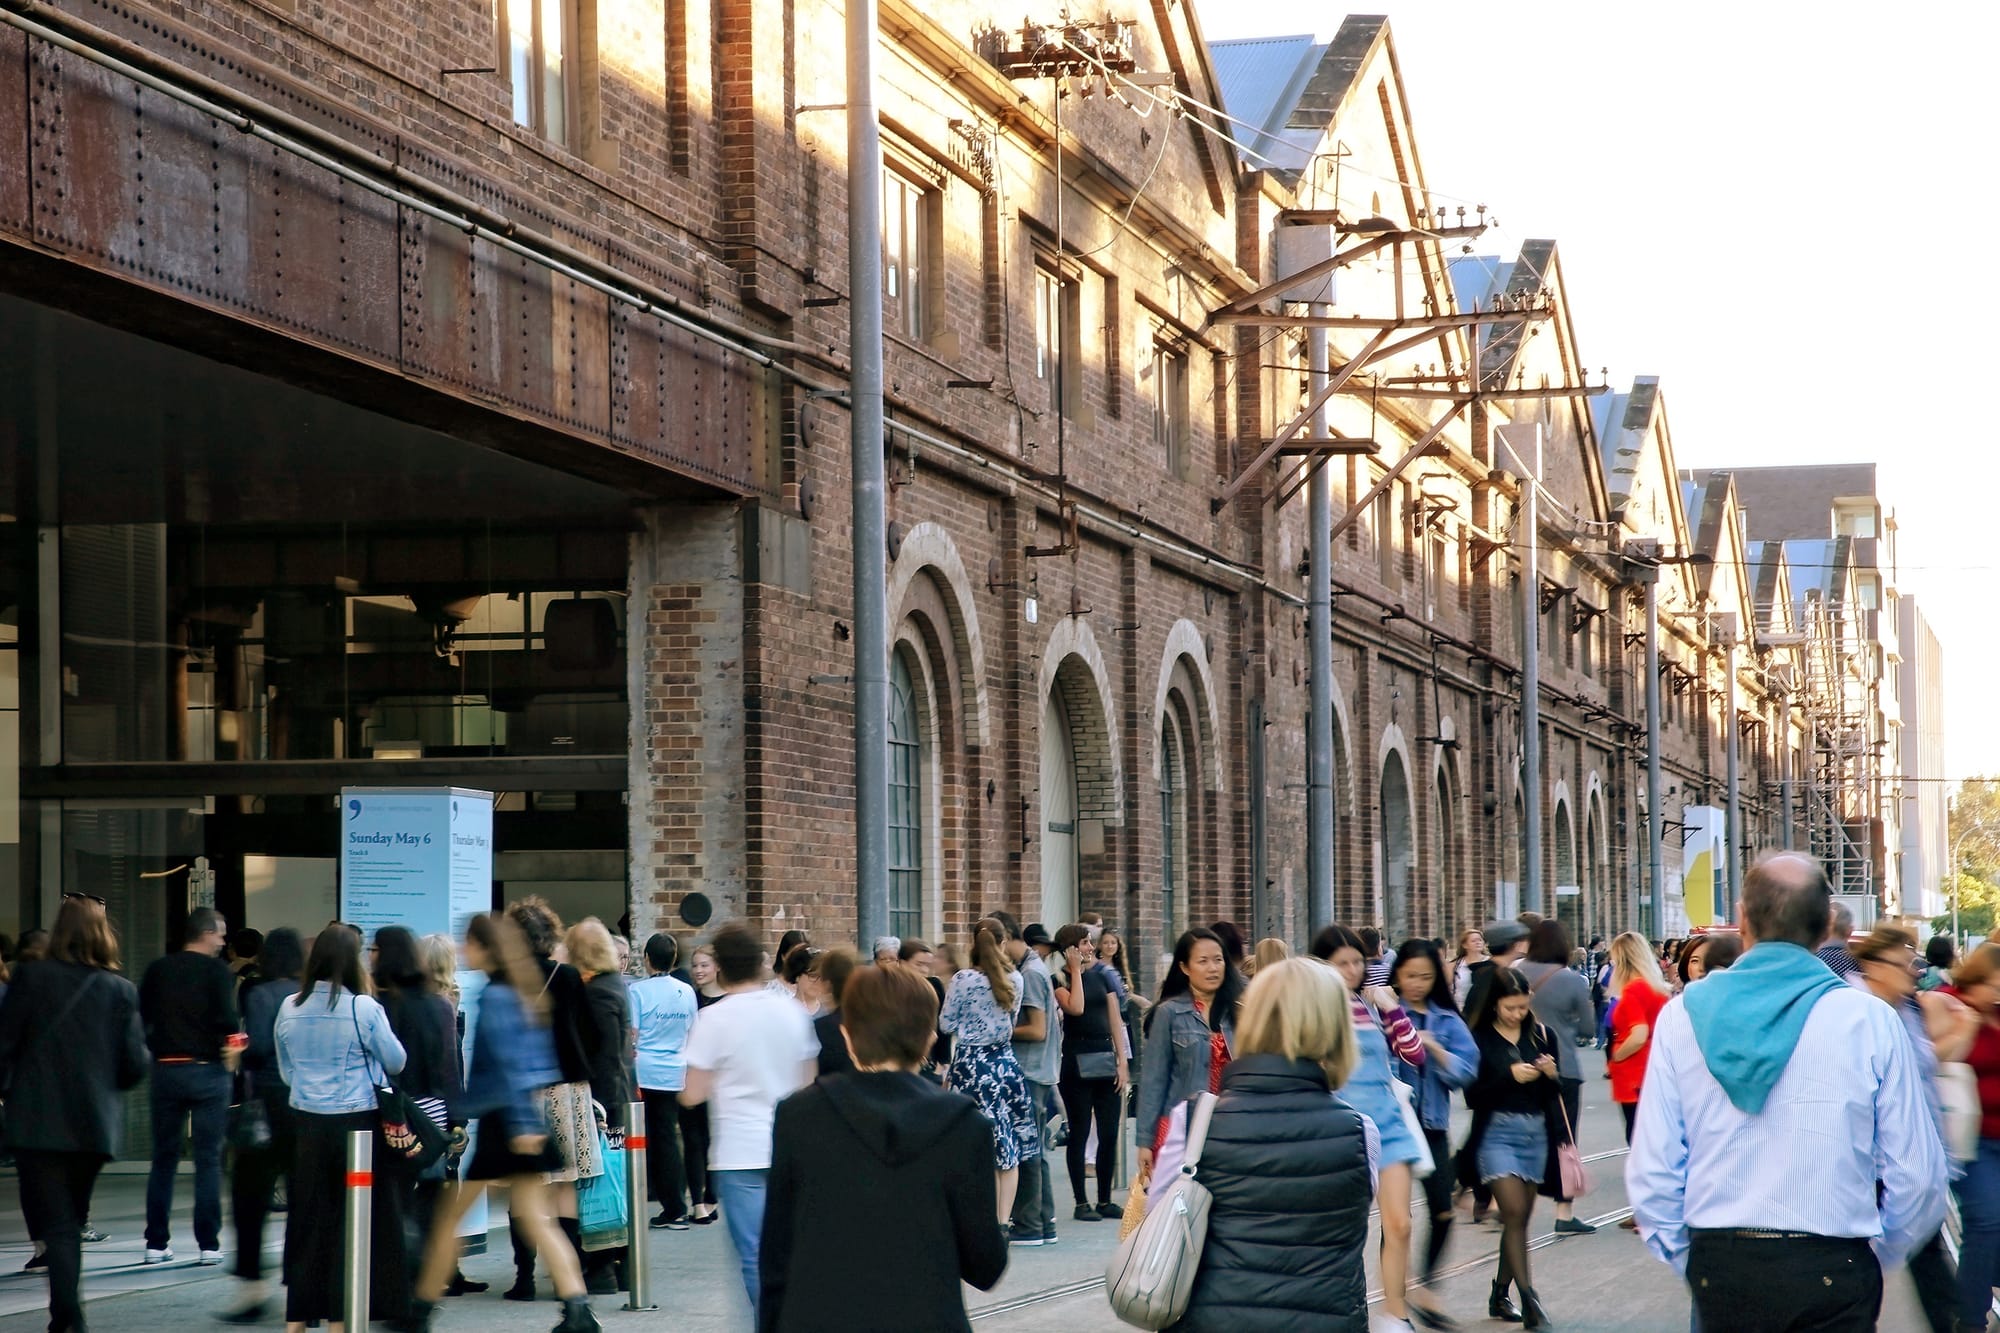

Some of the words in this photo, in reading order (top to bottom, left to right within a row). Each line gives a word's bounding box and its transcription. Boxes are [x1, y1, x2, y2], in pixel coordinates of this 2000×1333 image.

[349, 831, 393, 848] Sunday
[395, 832, 421, 848] May
[423, 832, 432, 845] 6
